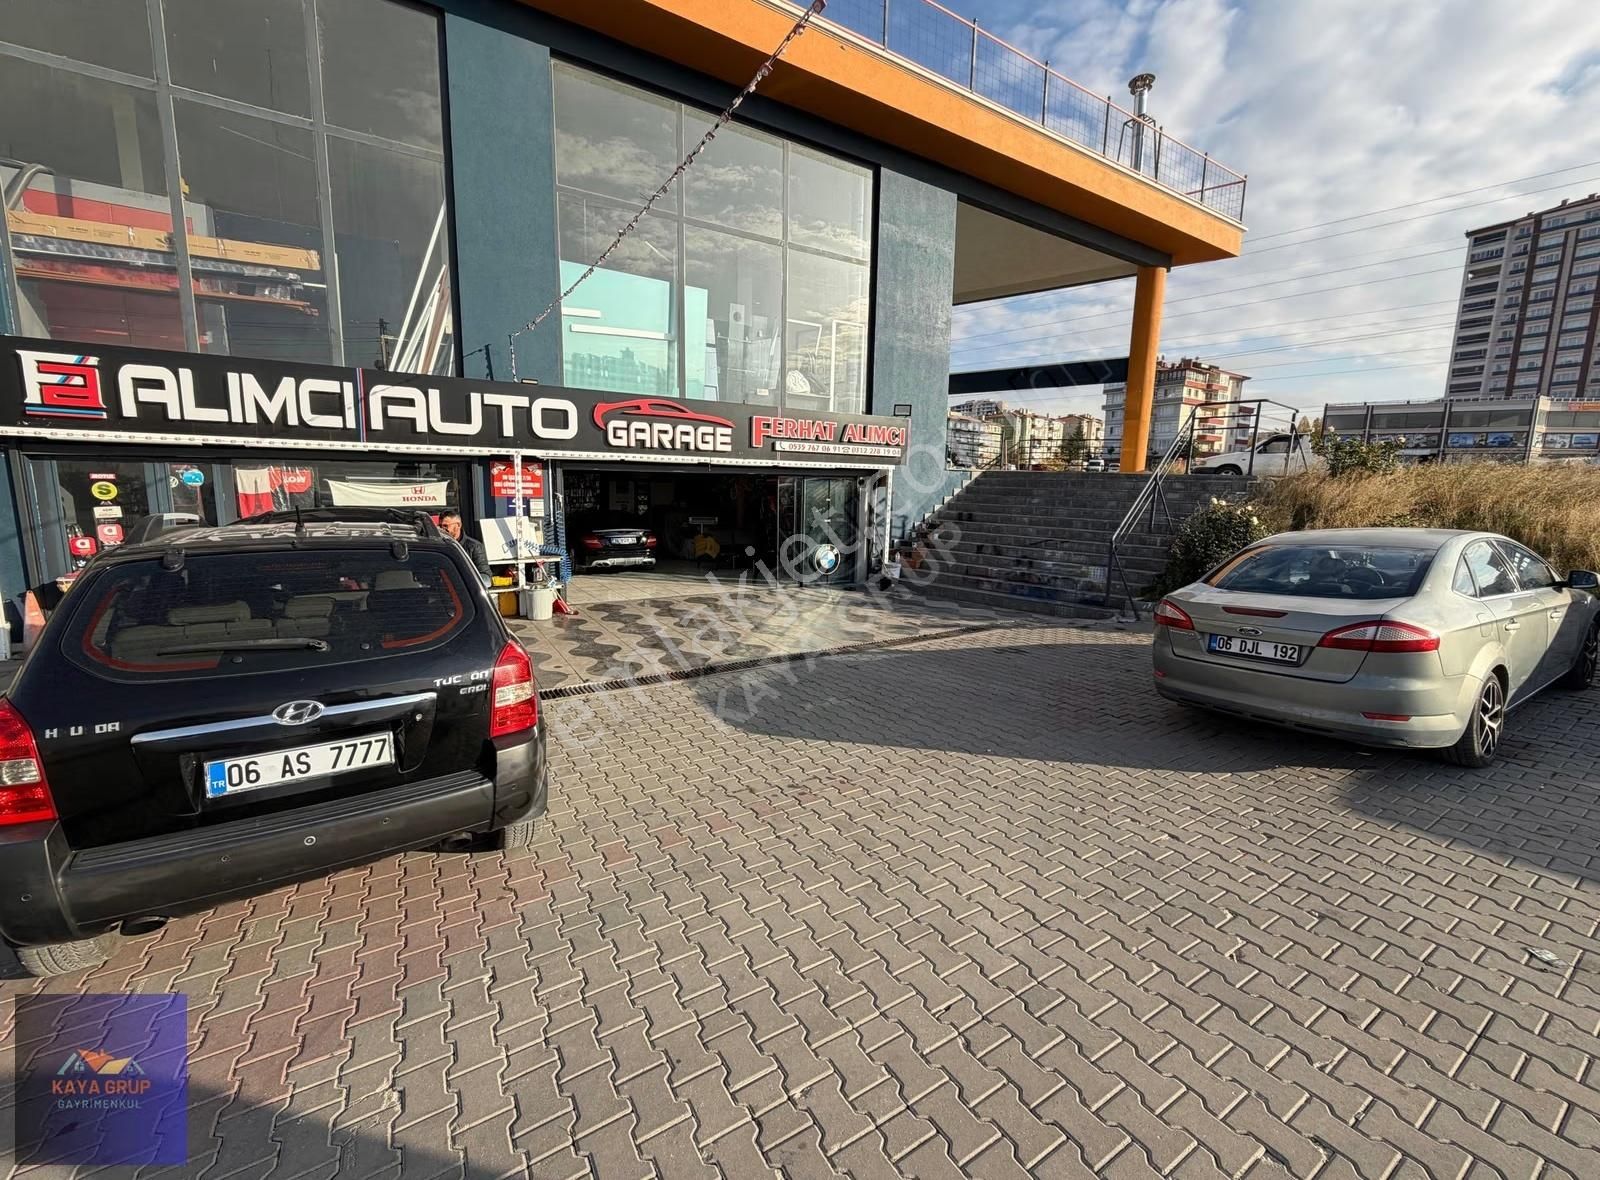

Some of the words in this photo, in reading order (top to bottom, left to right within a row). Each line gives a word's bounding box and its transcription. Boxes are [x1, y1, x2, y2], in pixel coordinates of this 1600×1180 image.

[118, 363, 356, 430] ALIMCI
[370, 384, 579, 440] AUTO
[607, 419, 733, 453] GARAGE
[752, 415, 838, 448] FERHAT
[843, 423, 906, 446] ALIMCI
[1217, 635, 1232, 650] 06
[1239, 640, 1262, 656] DJL
[1273, 645, 1298, 660] 192
[227, 760, 261, 788] 06
[281, 752, 312, 779] AS
[329, 738, 388, 770] 7777
[212, 780, 226, 789] TR
